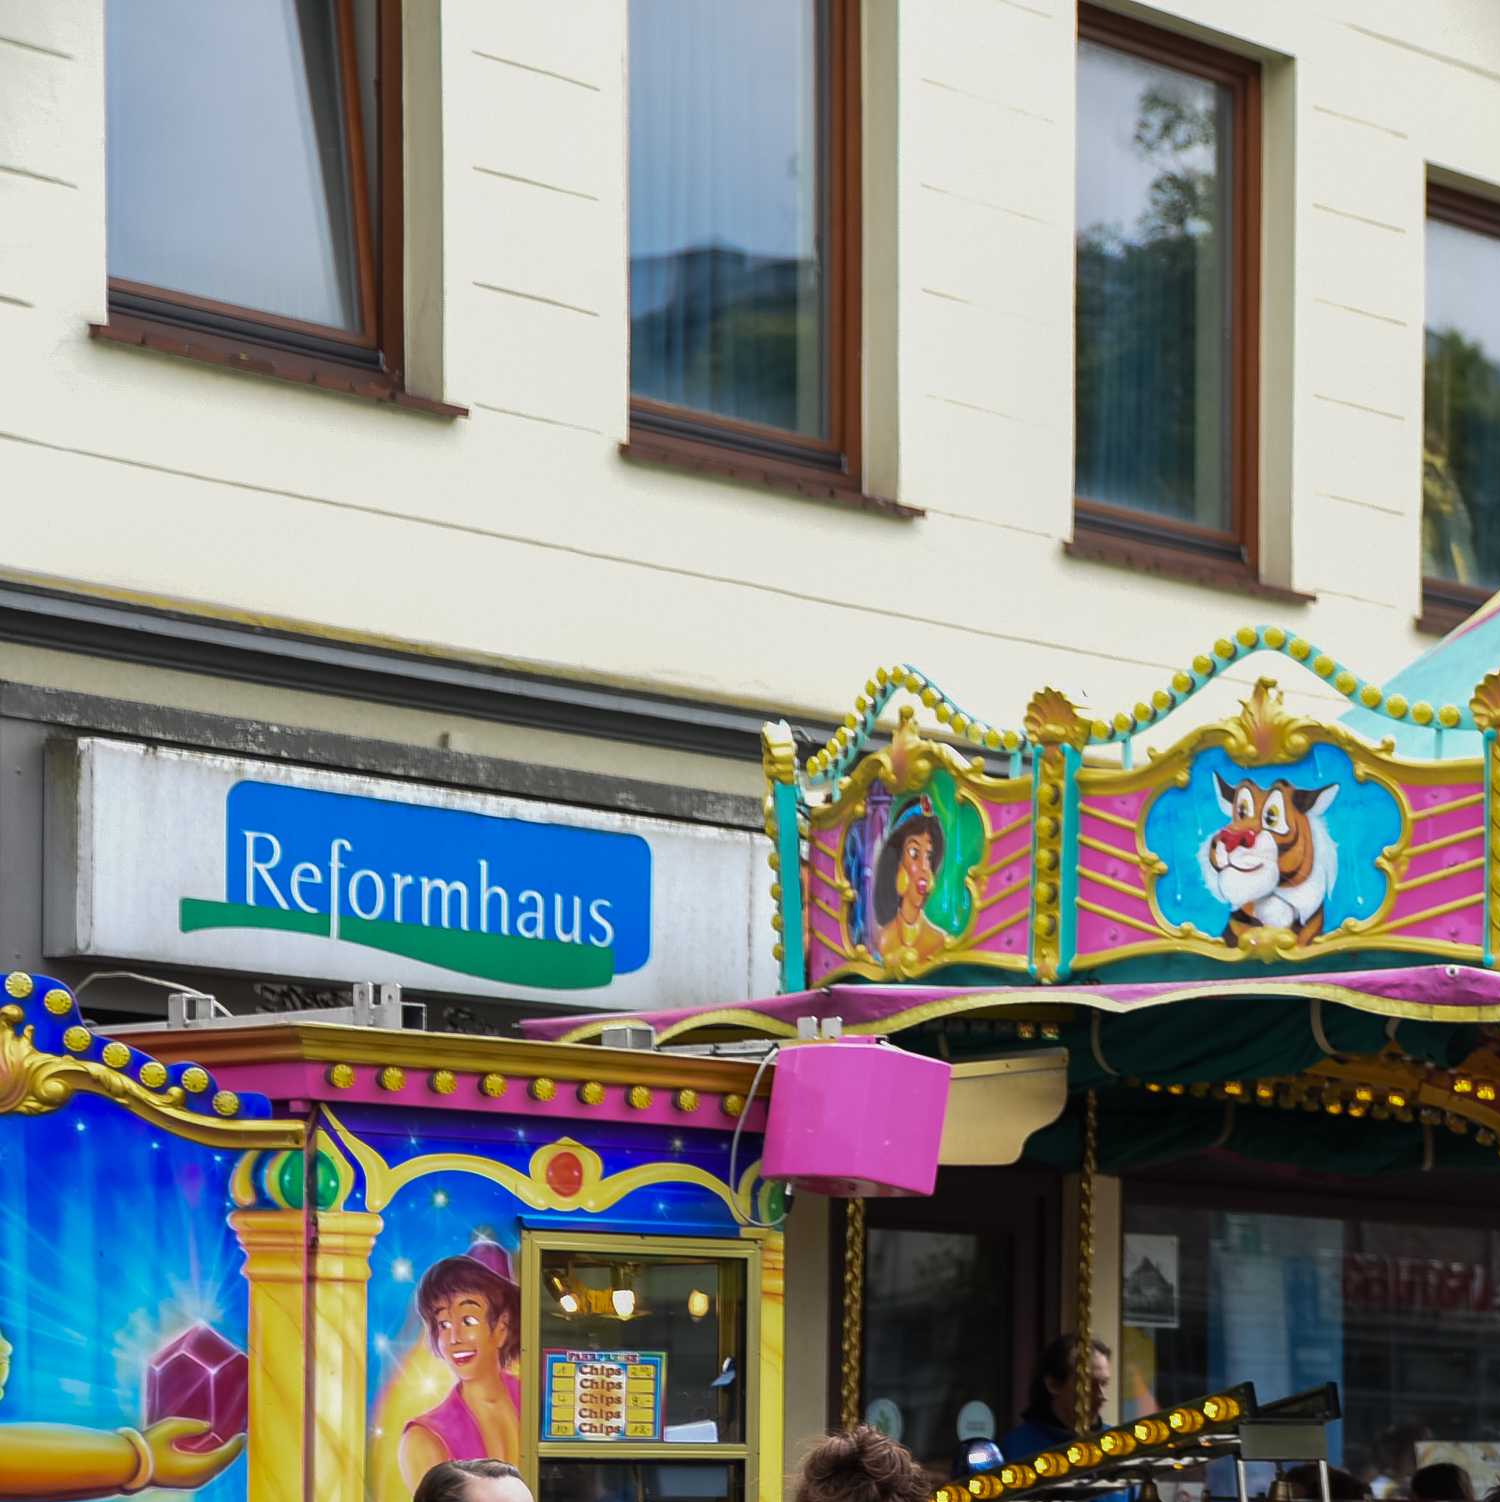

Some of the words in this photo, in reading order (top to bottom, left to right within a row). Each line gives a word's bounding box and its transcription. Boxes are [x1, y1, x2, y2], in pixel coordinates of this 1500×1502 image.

[240, 829, 615, 948] Reformhaus
[578, 1364, 622, 1378] Chips
[579, 1378, 622, 1392] Chips
[579, 1392, 622, 1406] Chips
[578, 1407, 622, 1421] Chips
[578, 1422, 621, 1435] Chips
